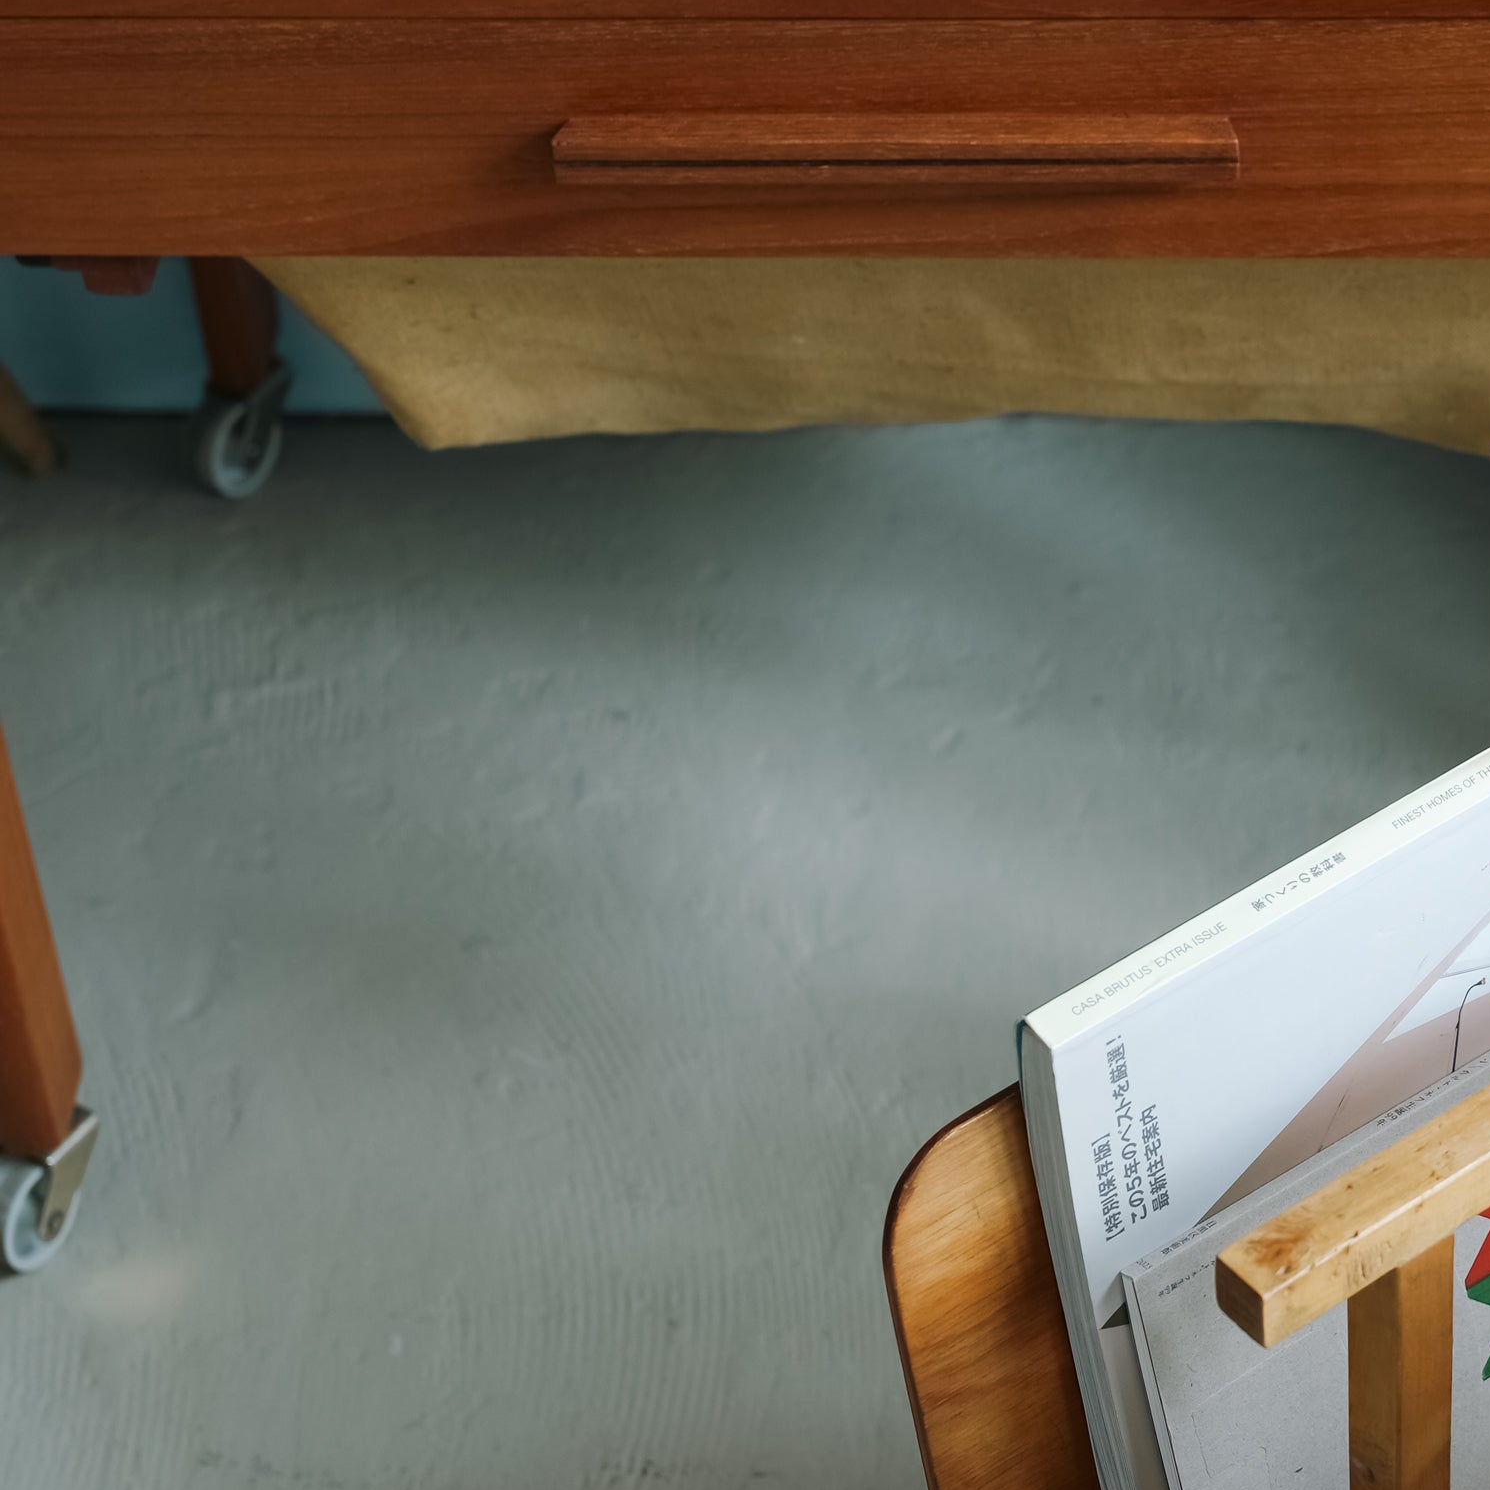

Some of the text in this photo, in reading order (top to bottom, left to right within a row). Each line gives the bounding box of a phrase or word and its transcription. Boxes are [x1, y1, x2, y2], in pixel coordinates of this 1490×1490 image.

[1391, 807, 1426, 830] FINEST
[1426, 784, 1463, 810] HOMES
[1462, 776, 1478, 789] OF
[1071, 922, 1227, 1017] CASA BRUTUS EXTRA ISSUE
[1139, 1104, 1170, 1212] 最新住宅案内
